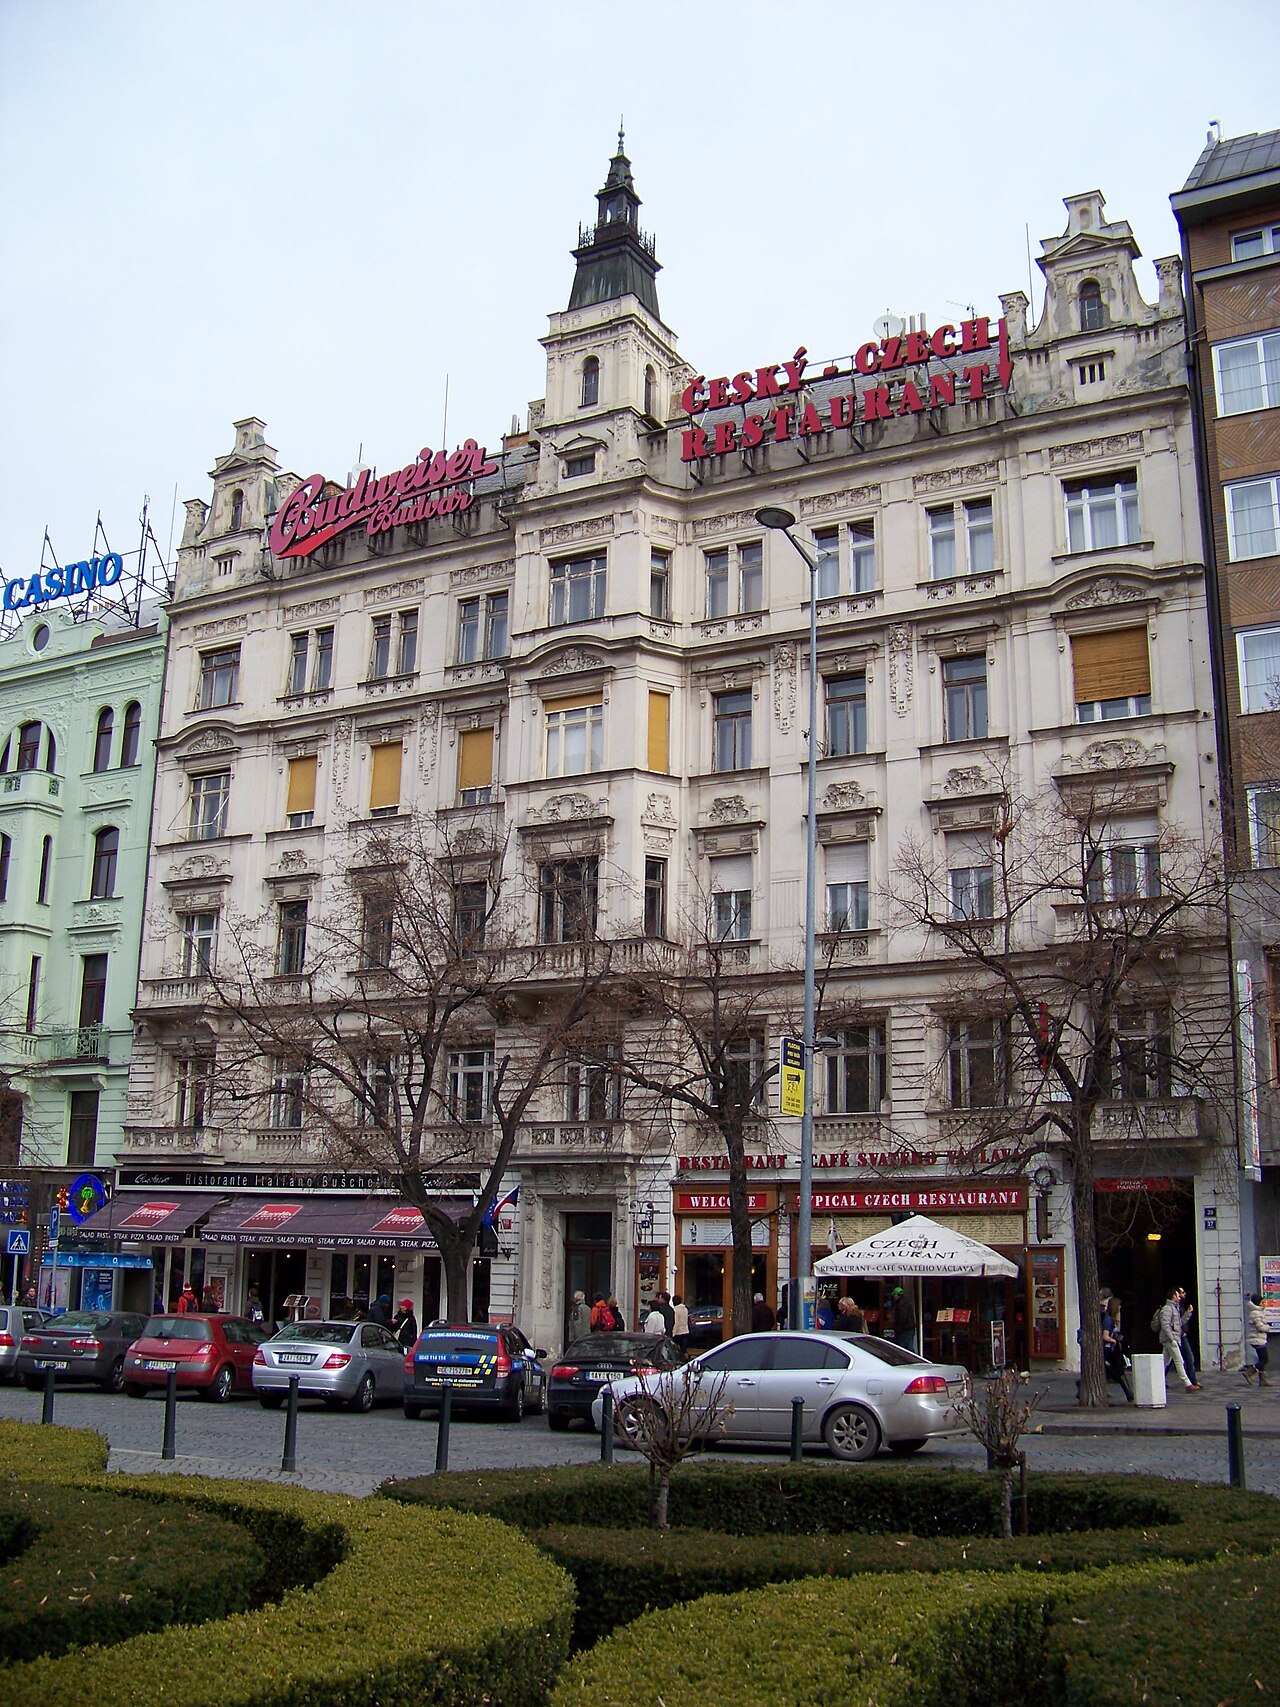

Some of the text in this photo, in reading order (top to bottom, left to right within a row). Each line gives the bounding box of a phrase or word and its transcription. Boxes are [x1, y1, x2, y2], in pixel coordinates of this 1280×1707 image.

[681, 347, 808, 415] ČESKÝ
[855, 317, 991, 375] CZECH
[680, 362, 990, 462] RESTAURANT
[270, 438, 499, 555] Budweiser
[367, 489, 474, 535] Budvar
[3, 552, 123, 610] CASINO
[679, 1154, 787, 1170] RESTARANT
[186, 1174, 248, 1186] Ristorante
[255, 1175, 312, 1187] Italiano
[690, 1196, 756, 1207] WELCE
[797, 1191, 1019, 1207] PICAL CZECH RESTAURANT
[52, 1210, 57, 1229] P
[147, 1233, 163, 1241] SALAD
[318, 1237, 335, 1245] STEAK
[869, 1239, 939, 1249] CZECH
[846, 1251, 959, 1259] RESTAURANT
[876, 1264, 895, 1272] CAFÉ
[897, 1264, 934, 1272] SVATÉHO
[936, 1264, 975, 1272] VÁCLAVA
